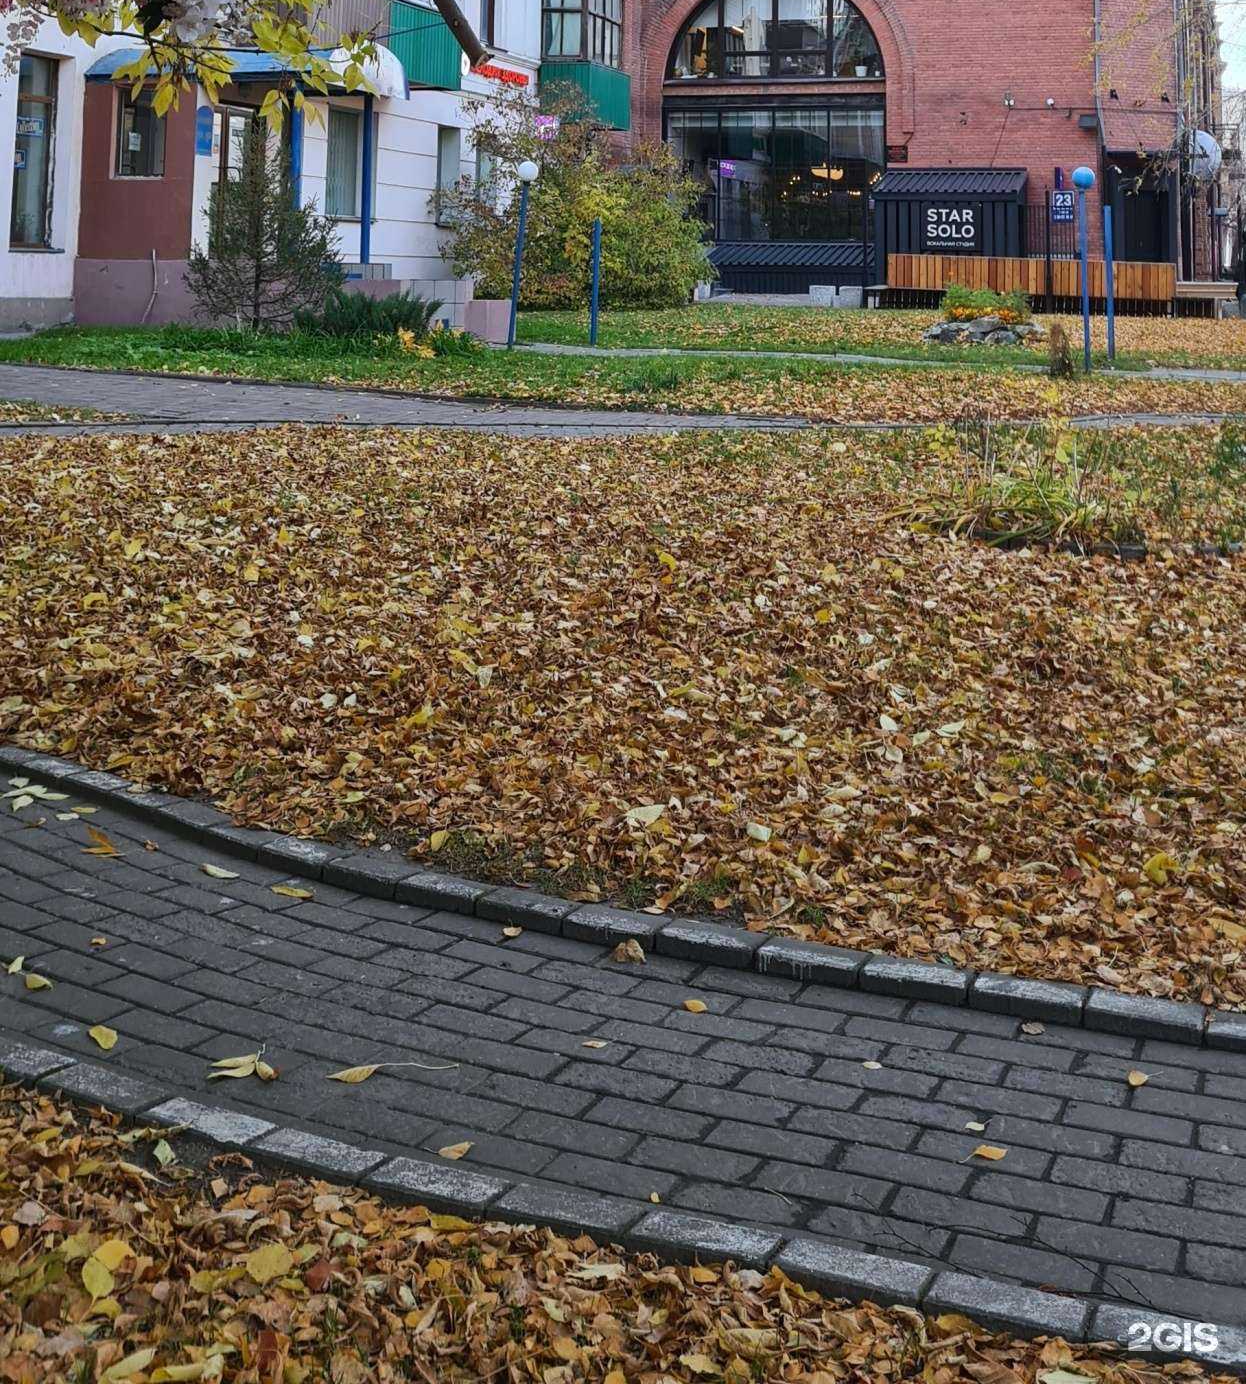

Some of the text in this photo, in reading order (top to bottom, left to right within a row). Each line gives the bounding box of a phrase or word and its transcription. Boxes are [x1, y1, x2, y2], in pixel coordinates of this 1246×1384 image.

[1055, 194, 1072, 206] 23
[927, 208, 974, 222] STAR
[926, 224, 975, 238] SOLO
